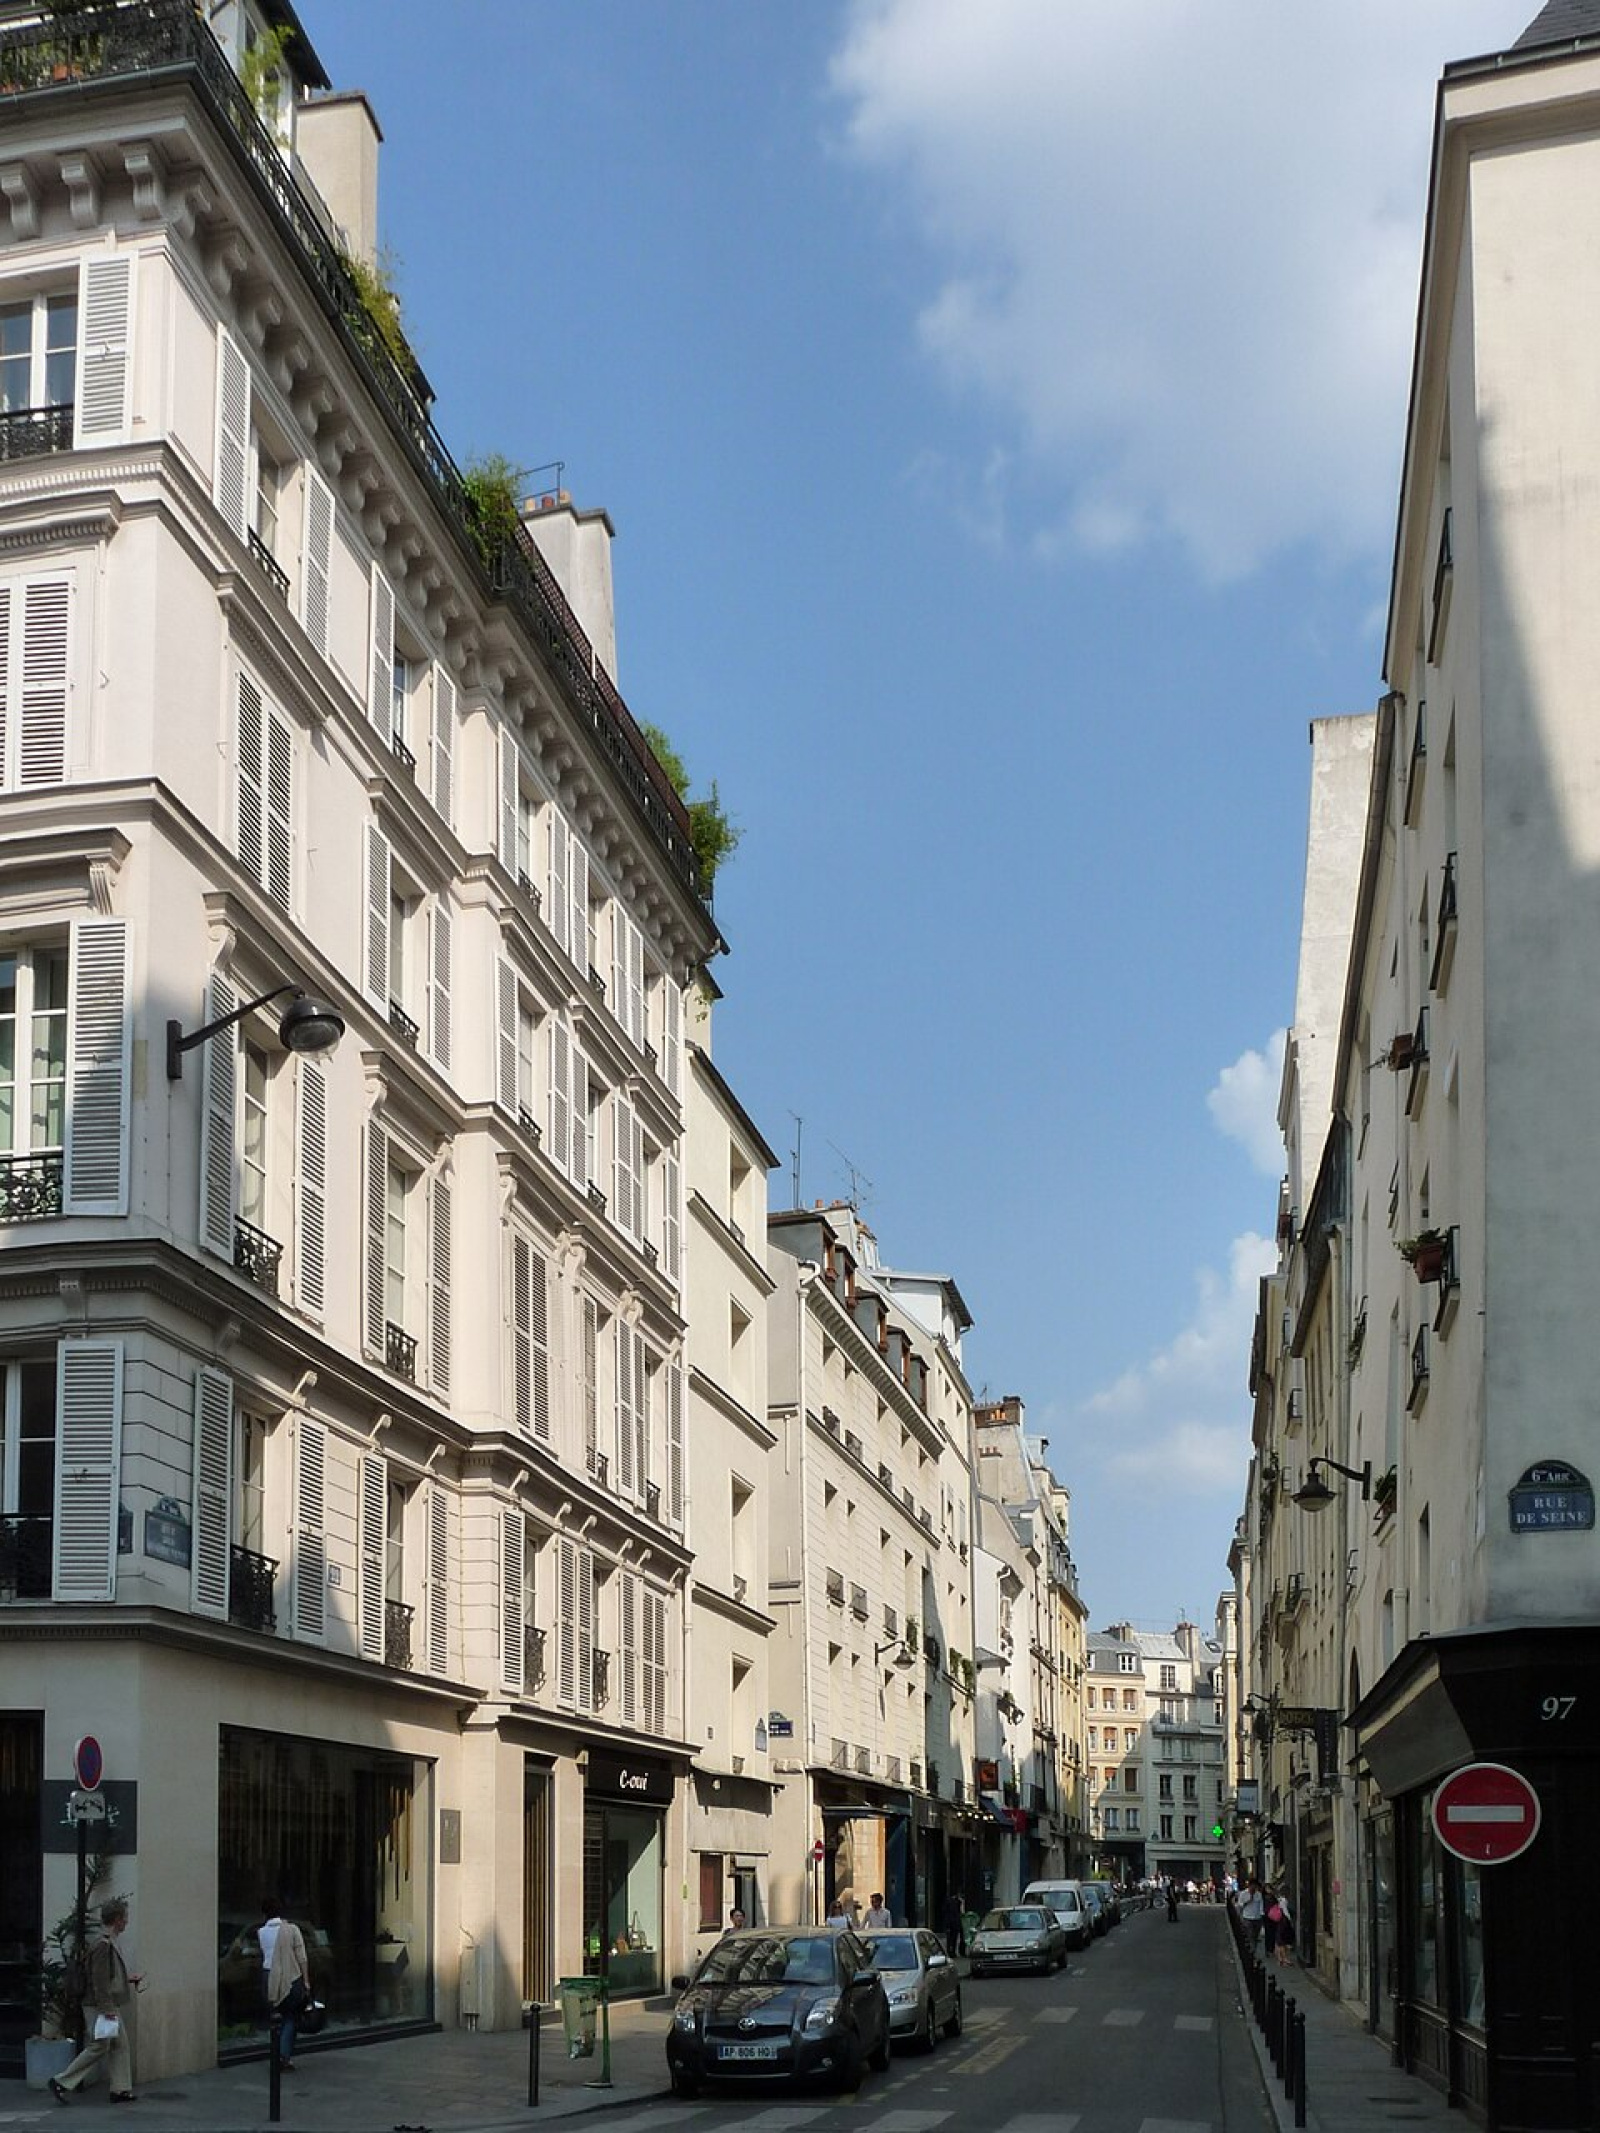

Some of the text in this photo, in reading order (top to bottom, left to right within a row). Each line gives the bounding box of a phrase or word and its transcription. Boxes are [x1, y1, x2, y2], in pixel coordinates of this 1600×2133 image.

[1534, 1497, 1568, 1509] RUE
[1516, 1510, 1586, 1524] DE SEINE
[1541, 1696, 1577, 1720] 97
